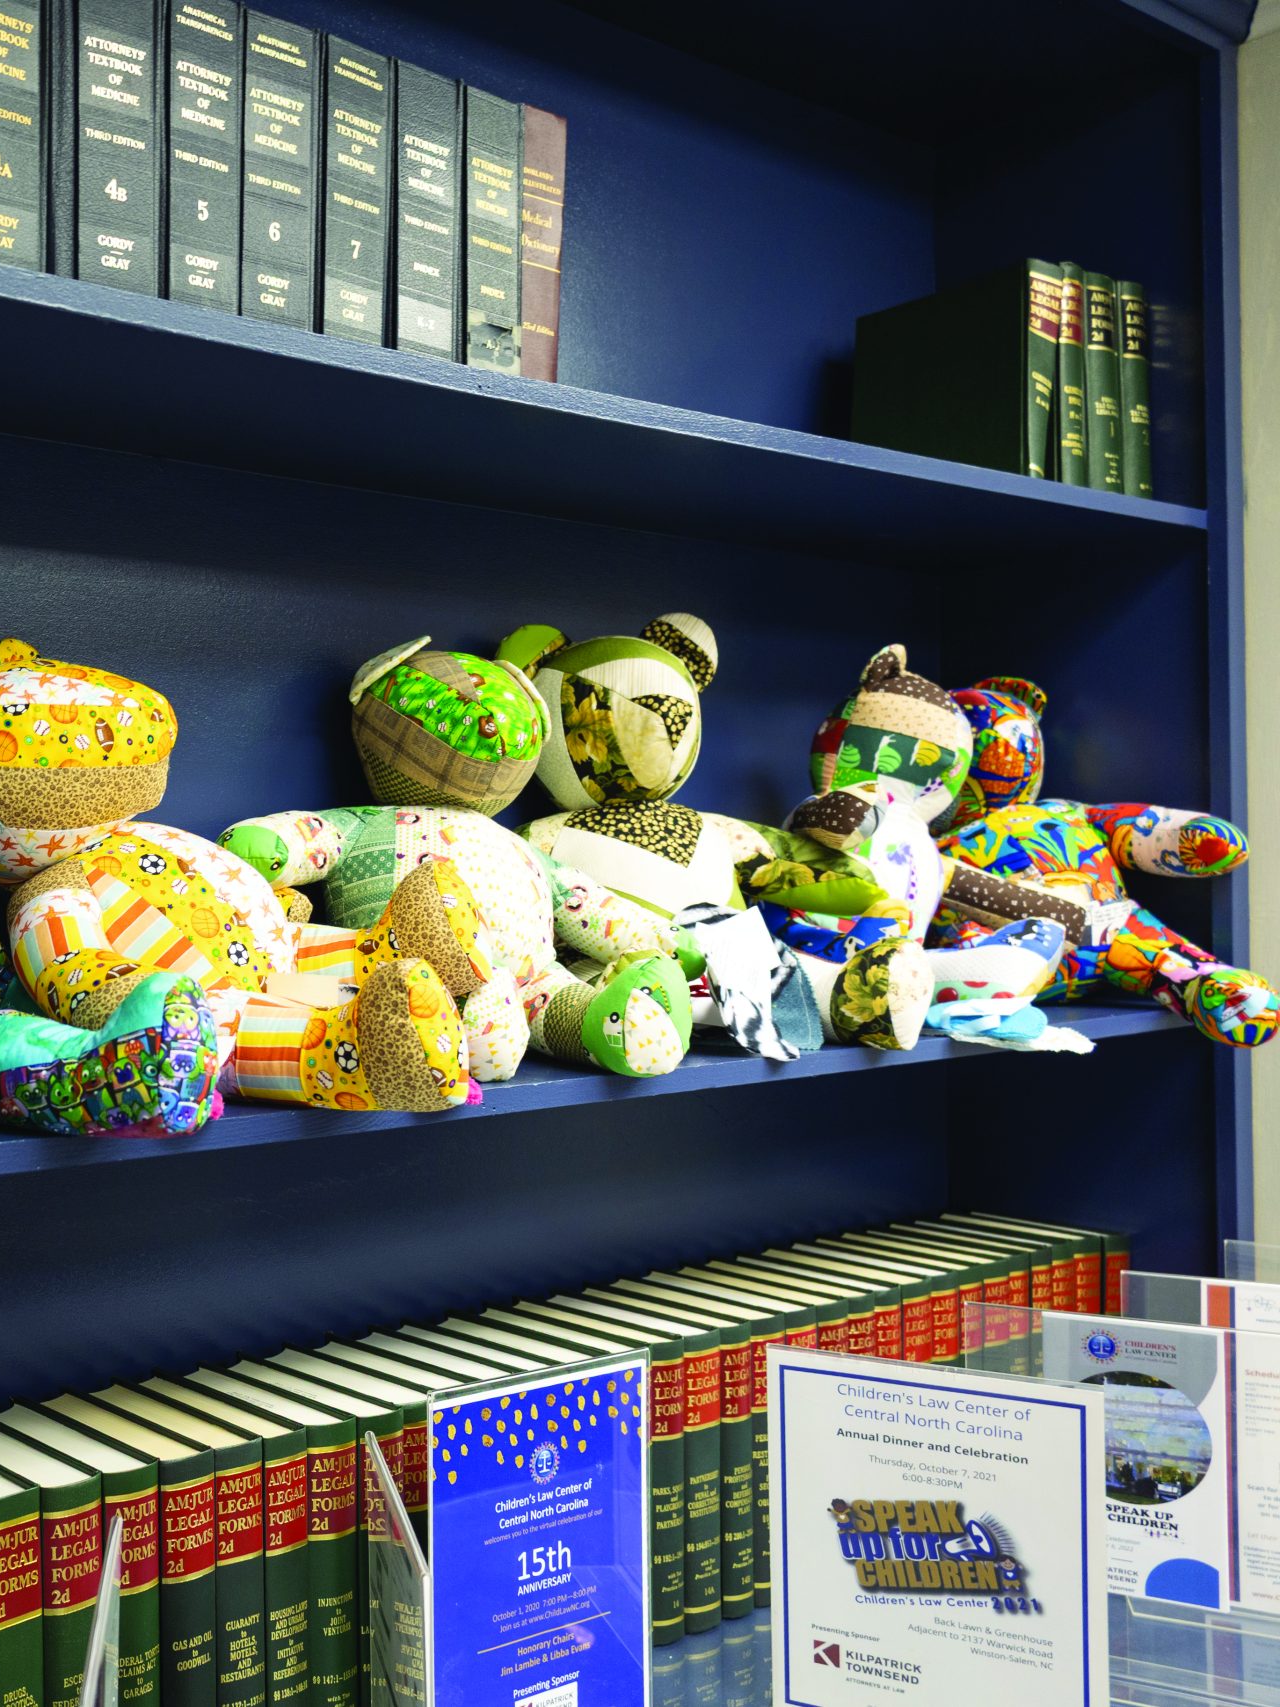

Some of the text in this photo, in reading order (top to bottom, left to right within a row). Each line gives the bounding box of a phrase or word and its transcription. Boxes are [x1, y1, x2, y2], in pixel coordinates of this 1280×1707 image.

[104, 178, 128, 203] 4B
[197, 200, 209, 221] 5
[97, 234, 135, 252] GORDY
[268, 222, 281, 242] 6
[351, 240, 361, 259] 7
[101, 255, 131, 271] GRAY
[1125, 1340, 1177, 1352] CHILDREN'S
[1125, 1347, 1141, 1355] LAW
[1144, 1349, 1177, 1360] CENTER
[837, 1383, 1032, 1422] Children's Law Center of
[844, 1404, 1024, 1442] Central North Carolina
[836, 1427, 1030, 1465] Annual Dinner and Celebration
[869, 1454, 998, 1482] Thursday, October 7, 2021
[312, 1472, 356, 1493] LEGAL
[902, 1473, 964, 1490] 6:00-8:30PM
[312, 1491, 356, 1512] FORMS
[495, 1478, 593, 1513] Children’s Law Center of
[312, 1517, 328, 1531] 2d
[499, 1498, 589, 1529] Central North Carolina
[851, 1500, 965, 1533] SPEAK
[1106, 1504, 1174, 1521] SPEAK UP
[1108, 1514, 1178, 1532] CHILDREN
[484, 1508, 603, 1545] welcomes you to the virtual celebration of our
[839, 1527, 945, 1562] up for
[517, 1540, 572, 1581] 15th
[517, 1572, 572, 1597] ANNIVERSARY
[854, 1560, 999, 1591] CHILDREN
[492, 1610, 520, 1623] October
[518, 1606, 524, 1616] 1,
[525, 1601, 540, 1613] 2020
[543, 1597, 556, 1607] 7:00
[855, 1594, 1042, 1612] Children's Law Center 2021
[225, 1612, 261, 1632] GUARANTY
[500, 1600, 591, 1634] Join us at www.ChildLawNC.org
[173, 1629, 214, 1652] GAS AND OIL
[230, 1635, 258, 1651] HOTELS,
[811, 1623, 881, 1642] Presenting Sponsor
[907, 1623, 1054, 1660] Adjacent to 2137 Warwick Road
[934, 1616, 1054, 1648] Back Lawn & Greenhouse
[192, 1649, 199, 1658] to
[230, 1646, 258, 1662] MOTELS,
[517, 1632, 576, 1657] Honorary Chairs
[177, 1652, 212, 1672] GOODWILL
[237, 1657, 252, 1671] AND
[500, 1641, 592, 1677] Jim Lambie & Libba Evans
[845, 1650, 923, 1674] KILPATRICK
[970, 1646, 1054, 1671] Winston-Salem, NC
[220, 1662, 266, 1684] RESTAURANTS
[513, 1670, 580, 1699] Presenting Sponsor
[845, 1661, 921, 1686] TOWNSEND
[124, 1680, 154, 1699] GARAGES
